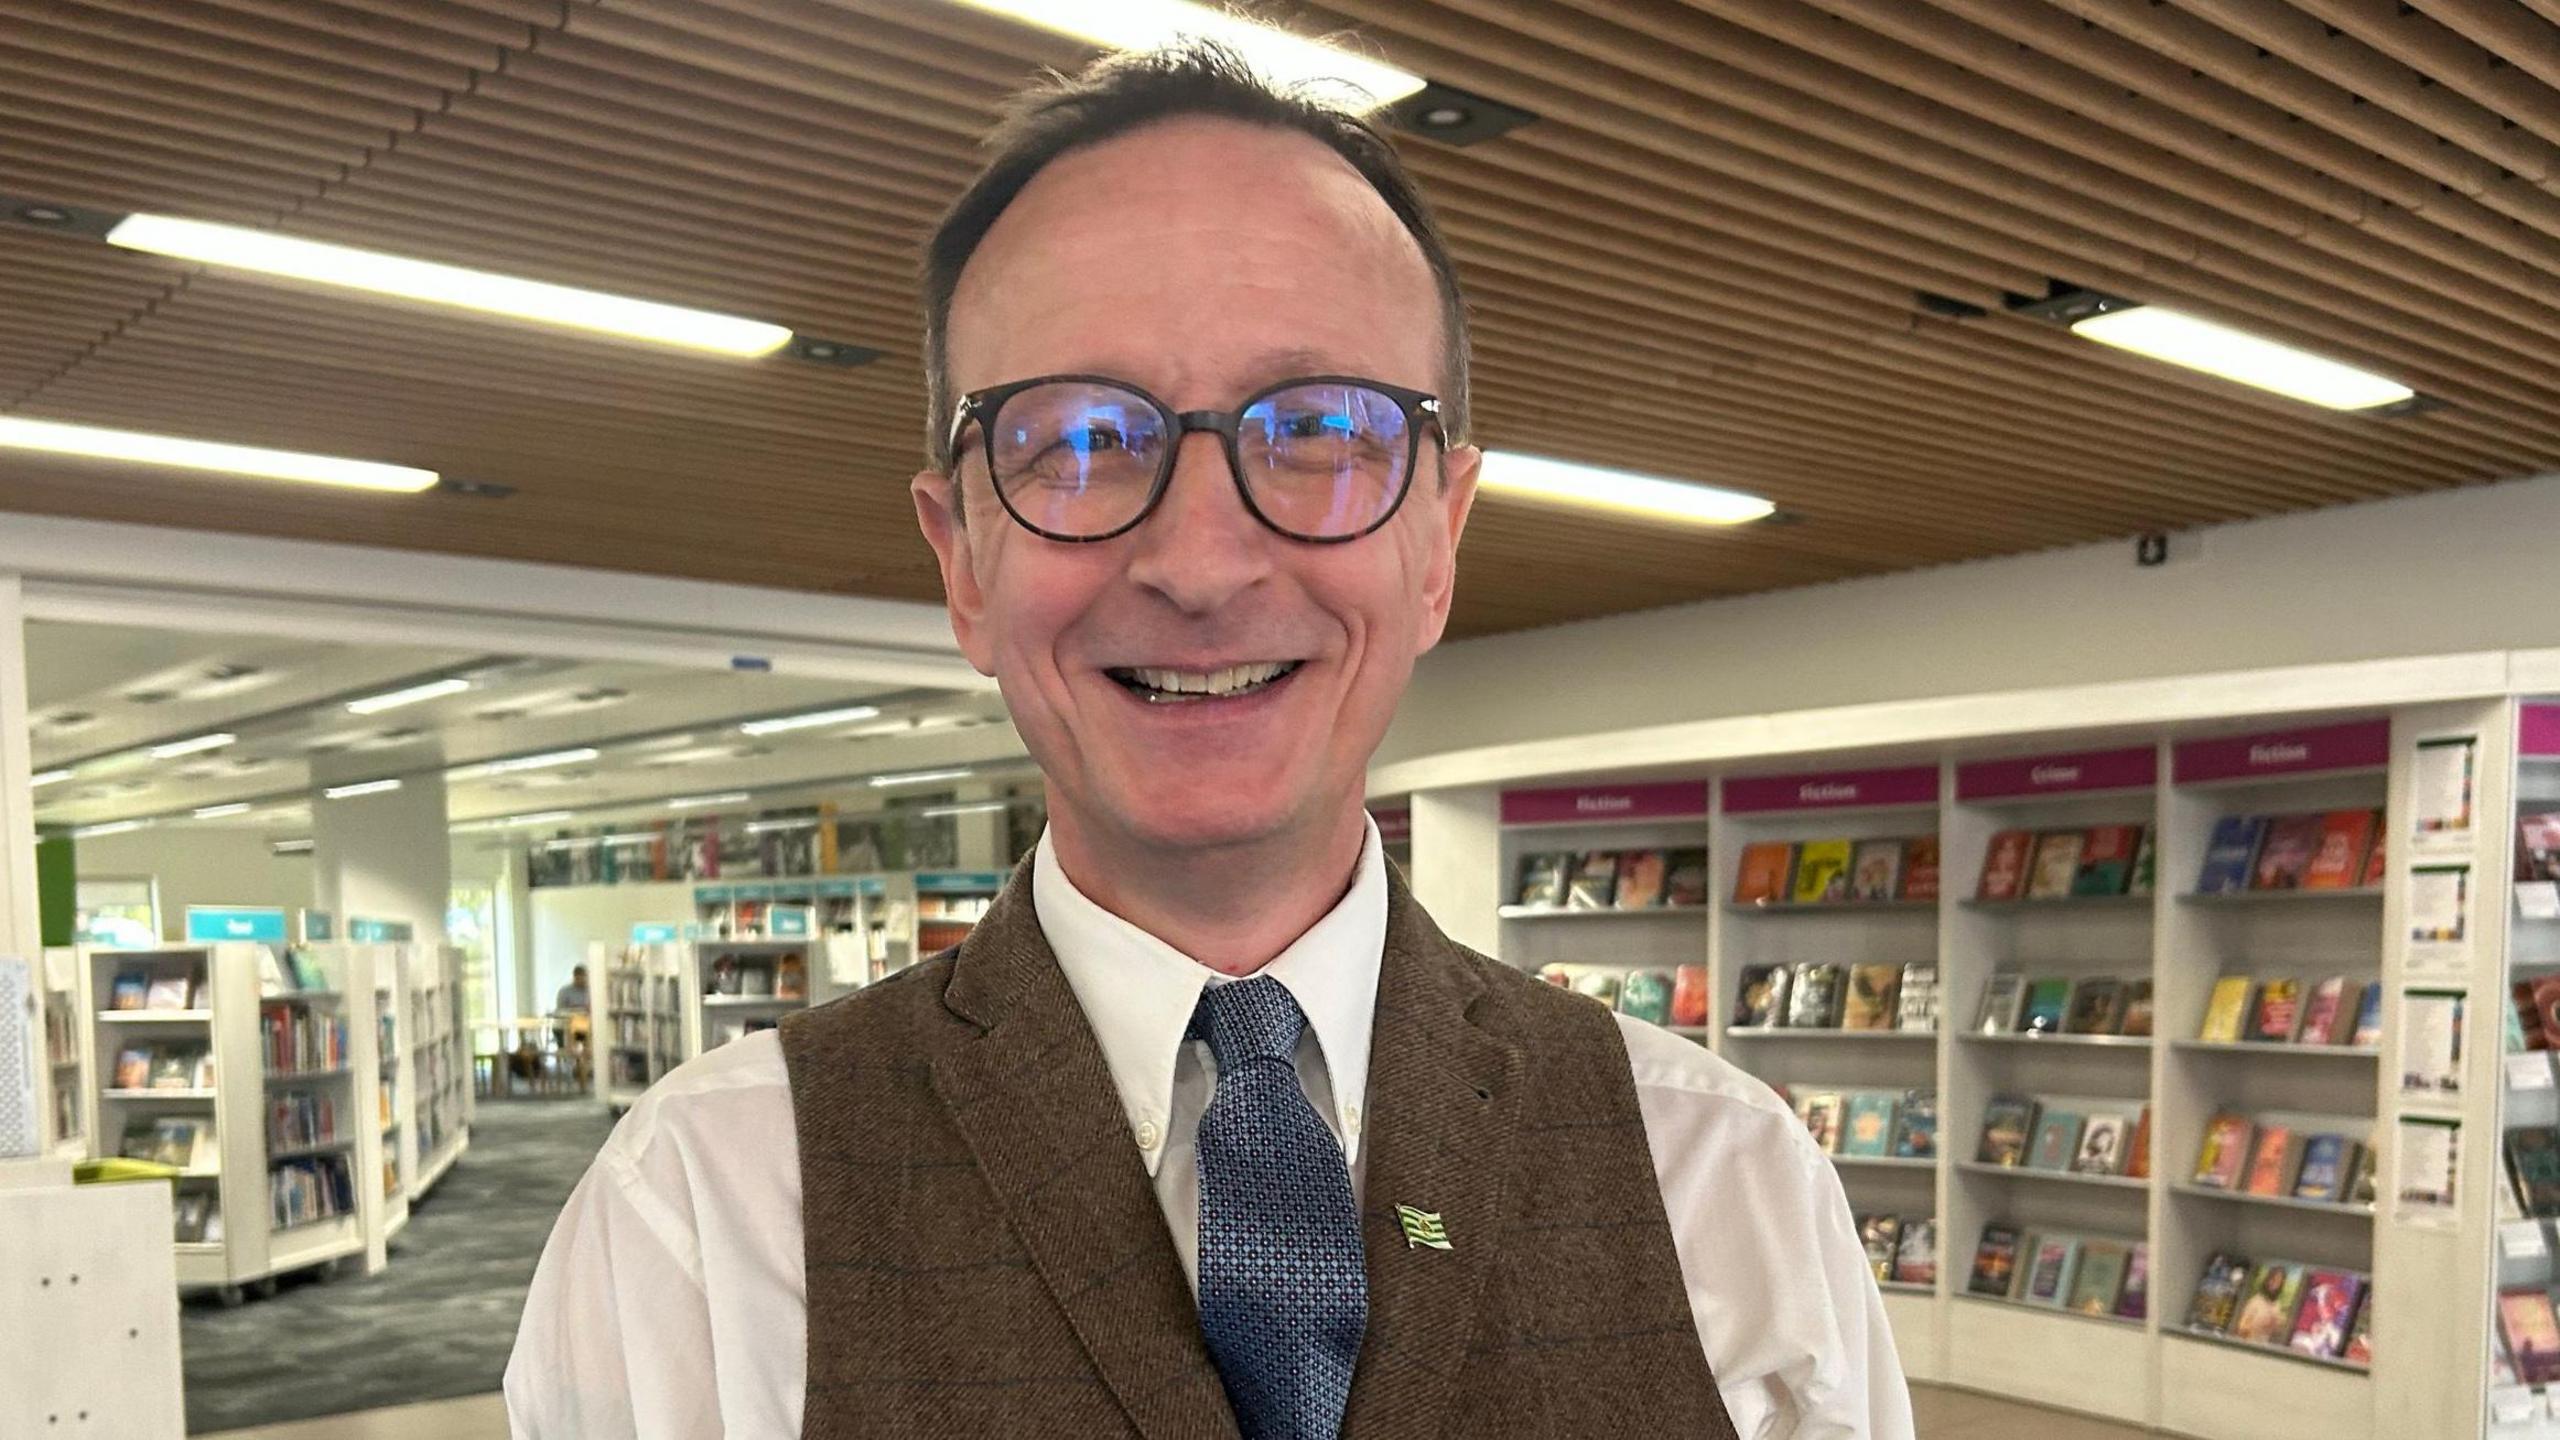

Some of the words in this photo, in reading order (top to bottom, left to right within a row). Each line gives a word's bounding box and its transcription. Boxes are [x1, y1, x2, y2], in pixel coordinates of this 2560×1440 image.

[2249, 744, 2308, 763] Fiction
[1799, 782, 1857, 800] Fiction
[1577, 795, 1632, 811] Fiction
